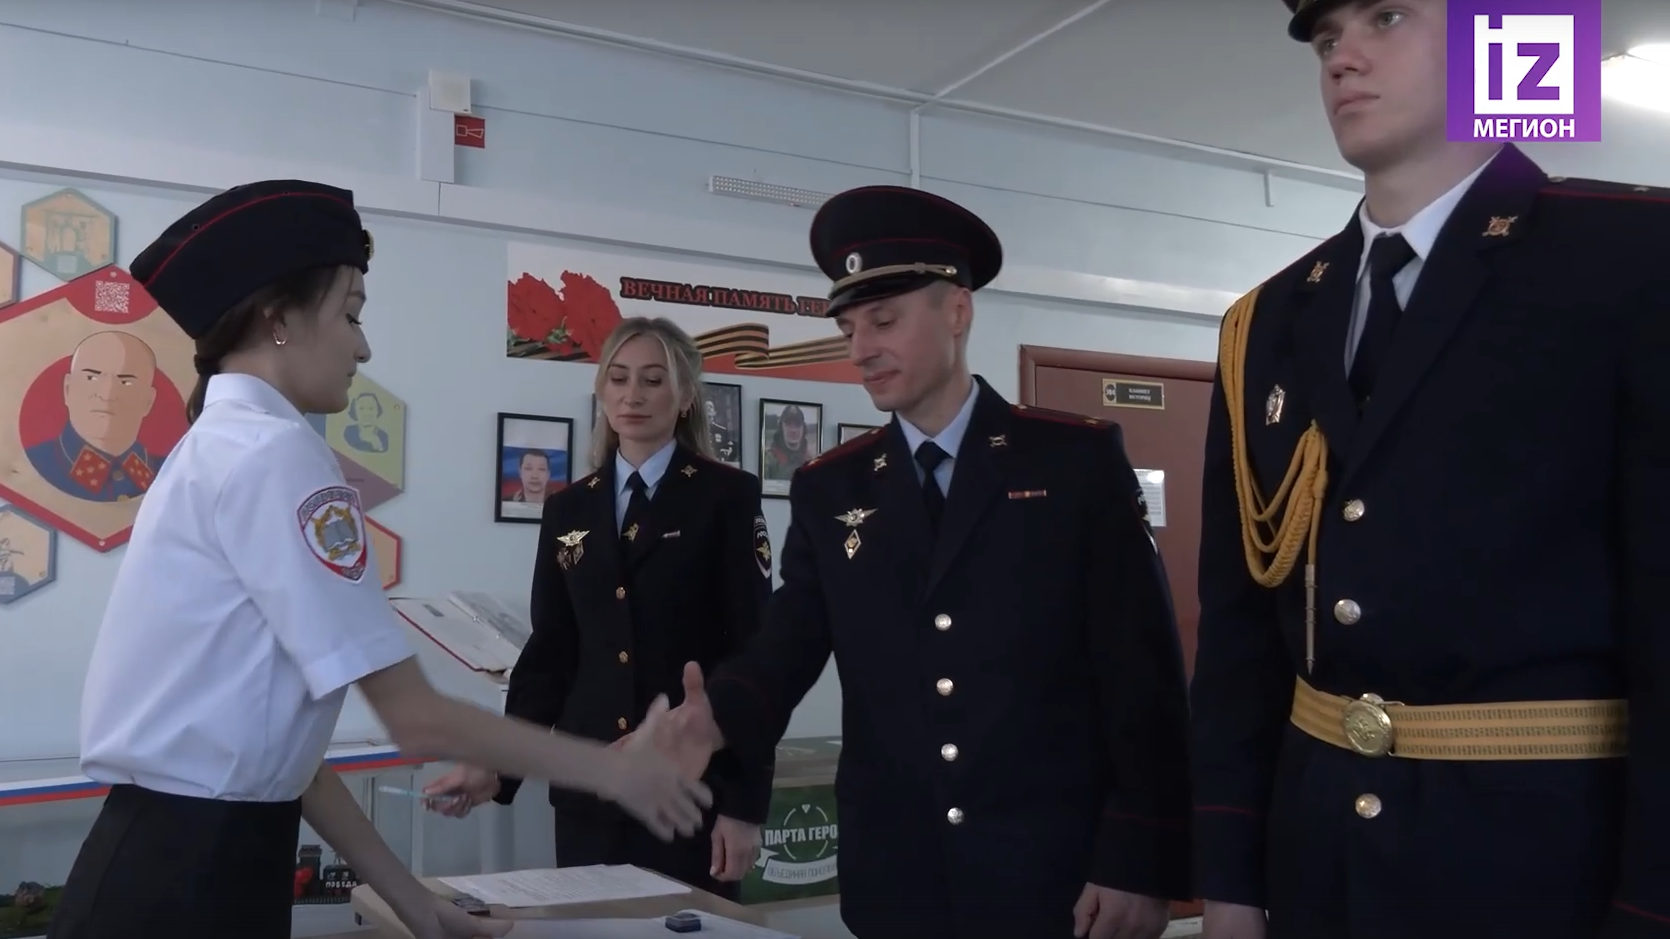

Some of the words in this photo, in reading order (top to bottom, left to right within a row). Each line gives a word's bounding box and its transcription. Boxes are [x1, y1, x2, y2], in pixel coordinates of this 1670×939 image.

[621, 278, 711, 305] ВЕЧНАЯ
[712, 288, 796, 314] ПАМЯТЬ
[765, 828, 806, 846] ПАРТА
